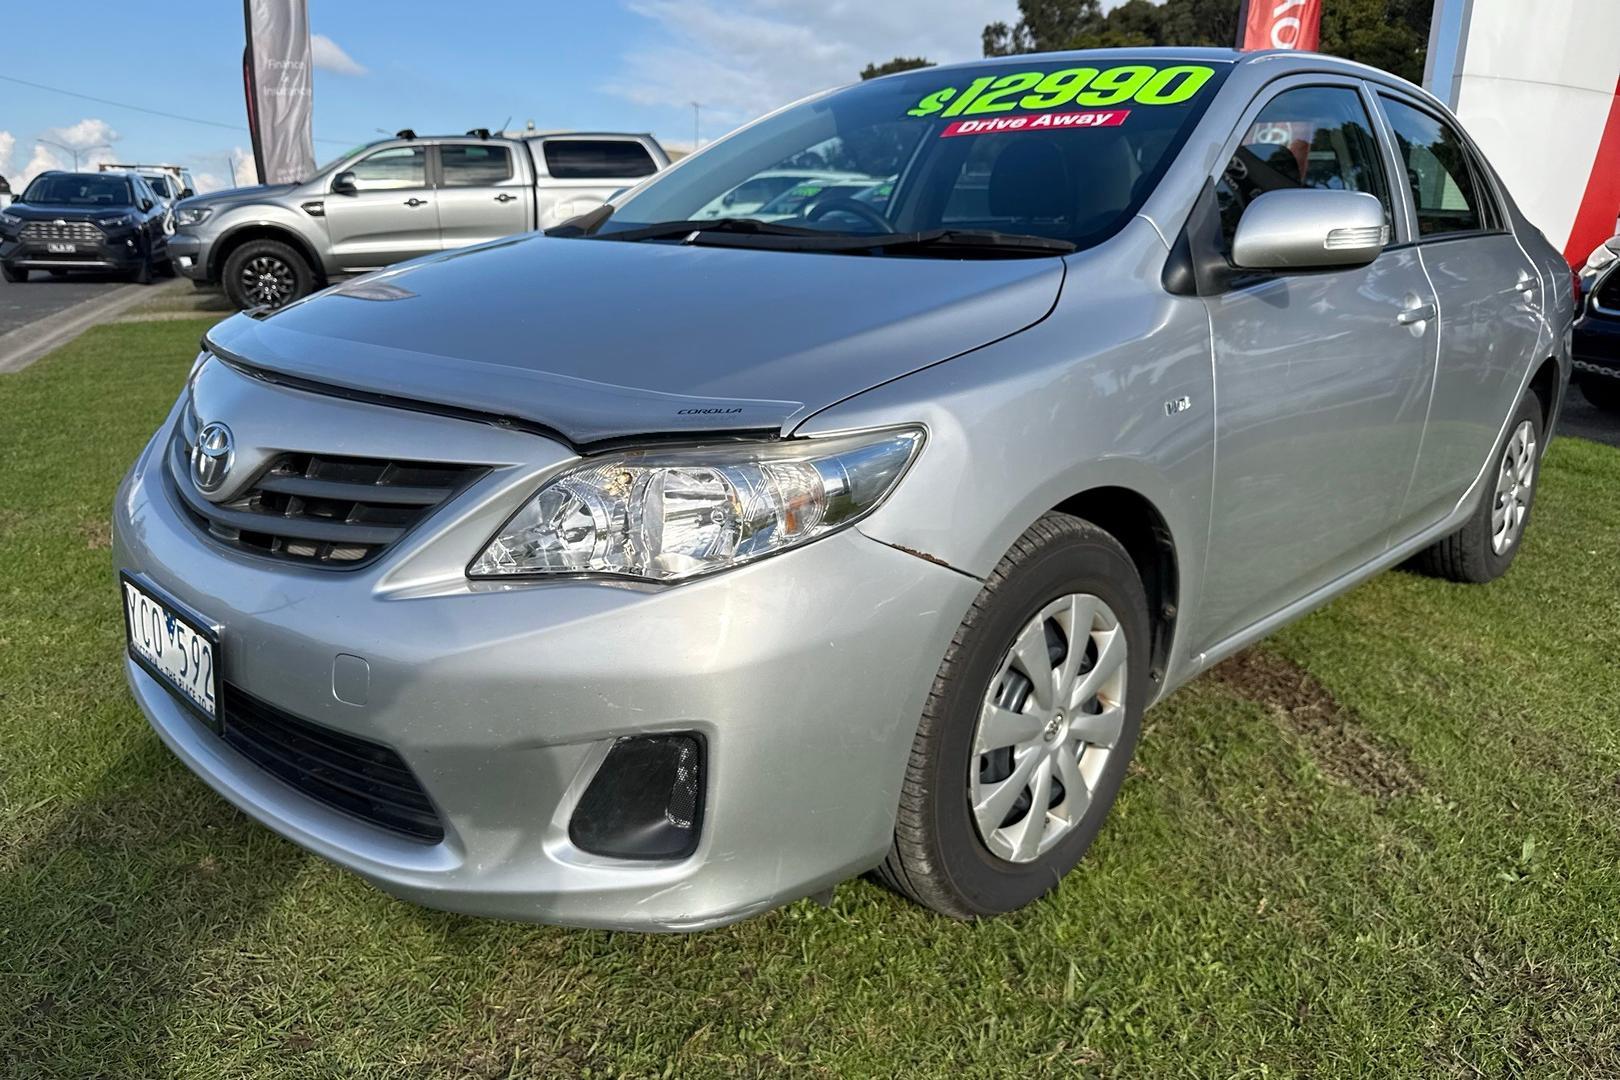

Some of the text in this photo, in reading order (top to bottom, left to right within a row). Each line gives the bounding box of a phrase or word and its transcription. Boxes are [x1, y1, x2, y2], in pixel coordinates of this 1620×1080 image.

[267, 59, 304, 69] Finance
[263, 86, 312, 96] Insurance
[907, 65, 1215, 117] $12990
[956, 113, 1113, 133] Drive Away
[176, 627, 215, 700] 592
